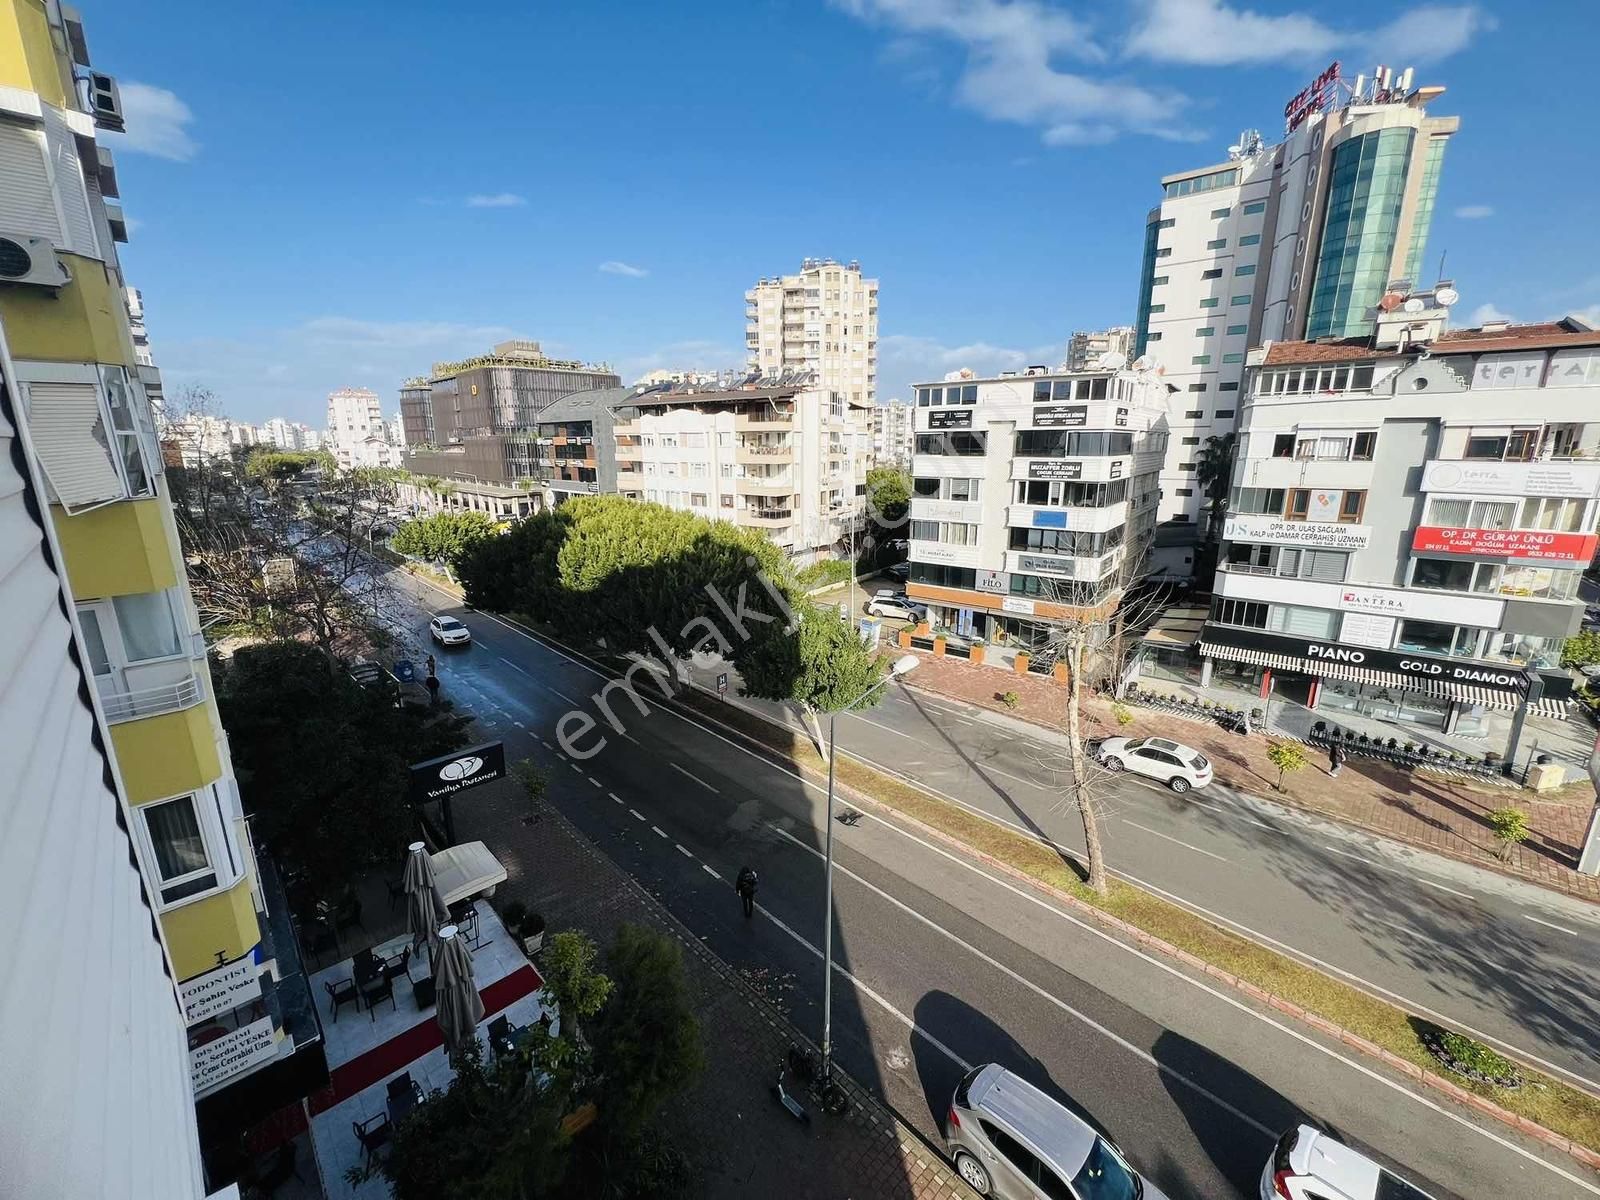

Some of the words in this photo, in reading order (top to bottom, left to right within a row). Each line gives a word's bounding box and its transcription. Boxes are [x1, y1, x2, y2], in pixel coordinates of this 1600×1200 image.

[1250, 530, 1266, 538] KALP
[1275, 532, 1300, 540] DAMAR
[1337, 536, 1367, 544] UZMANI
[1475, 540, 1504, 548] DOĞUM
[1483, 532, 1519, 542] GÜRAY
[1523, 533, 1554, 544] ÜNLÜ
[1307, 644, 1365, 663] PIANO
[1399, 659, 1442, 675] GOLD
[1453, 668, 1518, 687] DIAMON
[427, 783, 460, 798] Vanilya
[461, 770, 498, 787] Pastanesi
[181, 966, 248, 999] TODONTİST
[228, 978, 255, 992] Veske
[239, 1028, 272, 1047] VESKE
